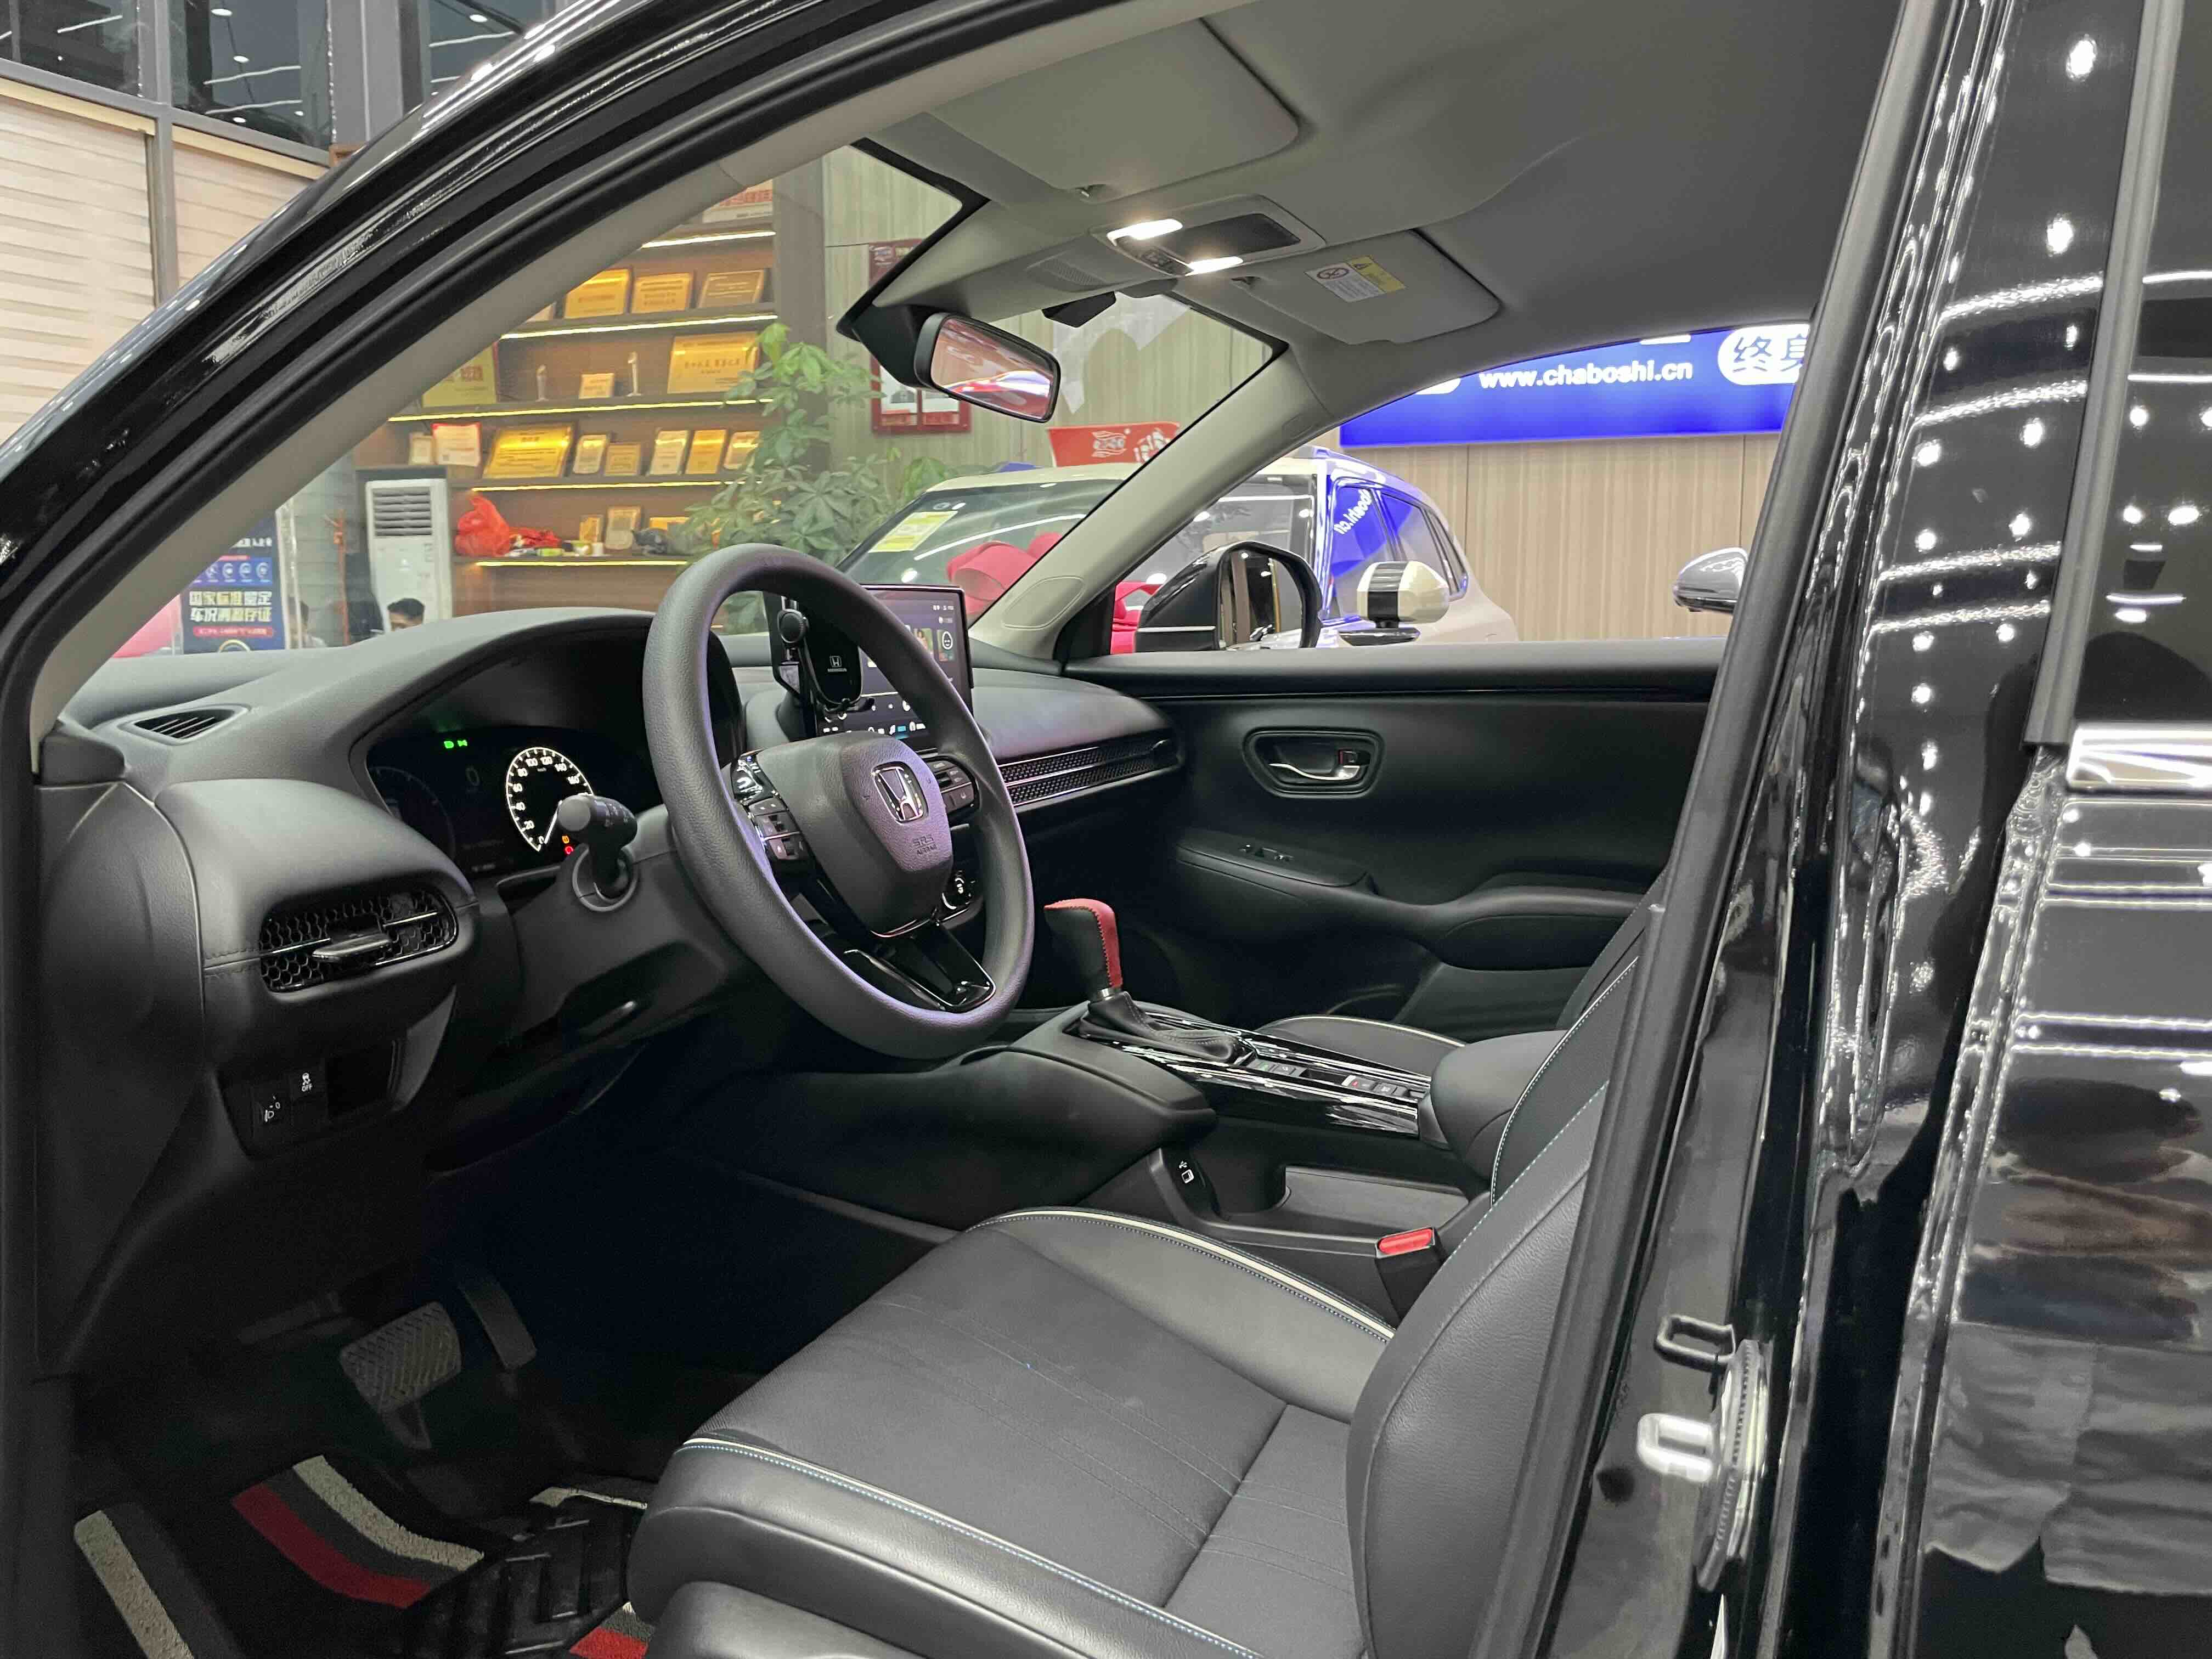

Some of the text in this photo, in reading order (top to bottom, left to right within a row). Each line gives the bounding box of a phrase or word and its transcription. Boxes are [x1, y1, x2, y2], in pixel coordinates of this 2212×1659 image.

[1479, 359, 1692, 388] www.chaboshi.cn
[526, 758, 538, 767] 100
[540, 757, 552, 765] 120
[555, 763, 567, 772] 140
[517, 768, 528, 777] 80
[567, 776, 580, 785] 160
[512, 783, 523, 792] 60
[516, 802, 526, 811] 40
[523, 820, 535, 830] 20
